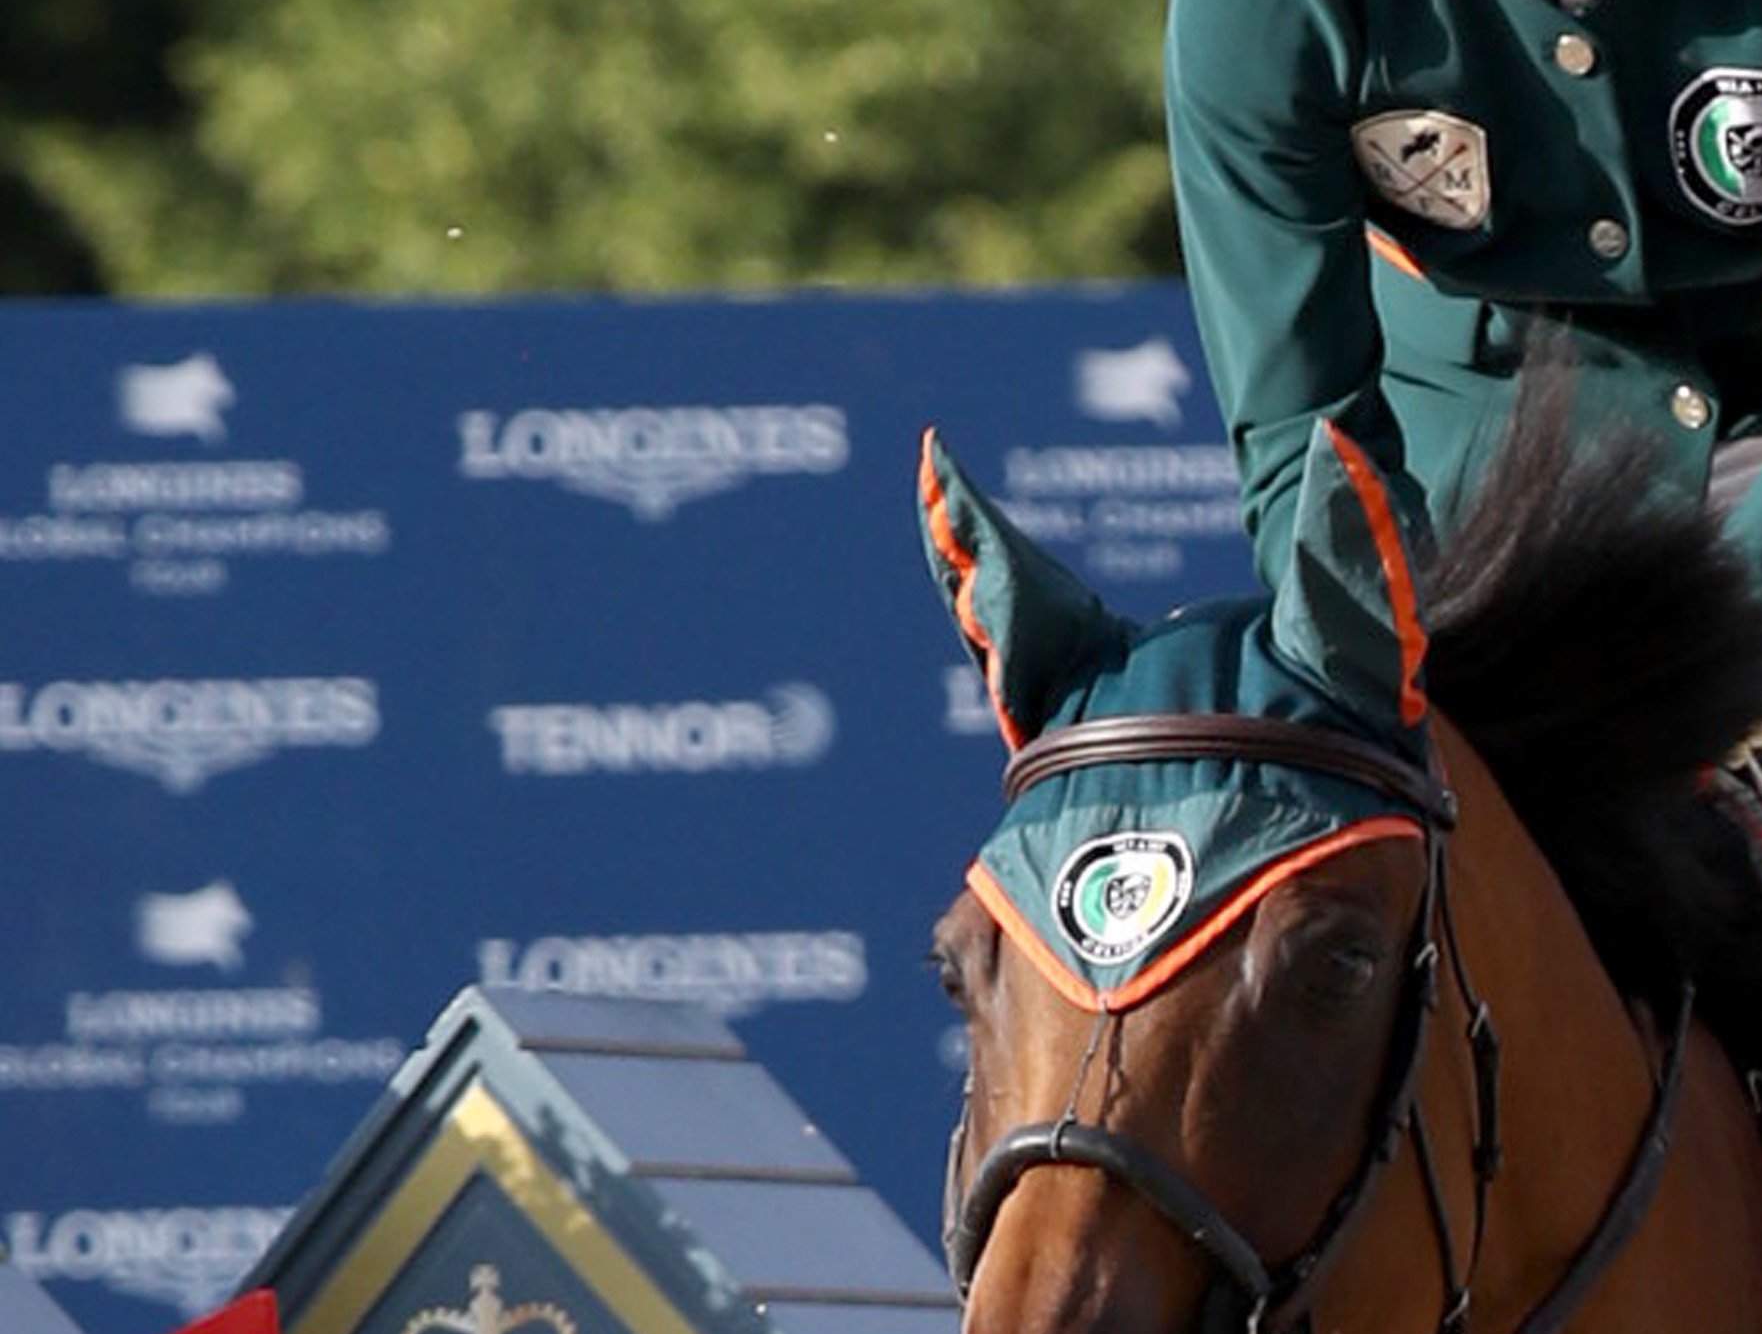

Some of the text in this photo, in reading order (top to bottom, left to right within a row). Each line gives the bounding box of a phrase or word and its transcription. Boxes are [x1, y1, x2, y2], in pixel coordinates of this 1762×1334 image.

[457, 405, 849, 479] LONGINES
[0, 677, 380, 751] LONGINES
[491, 700, 776, 774] TENNOR
[478, 931, 869, 997] LONGINES
